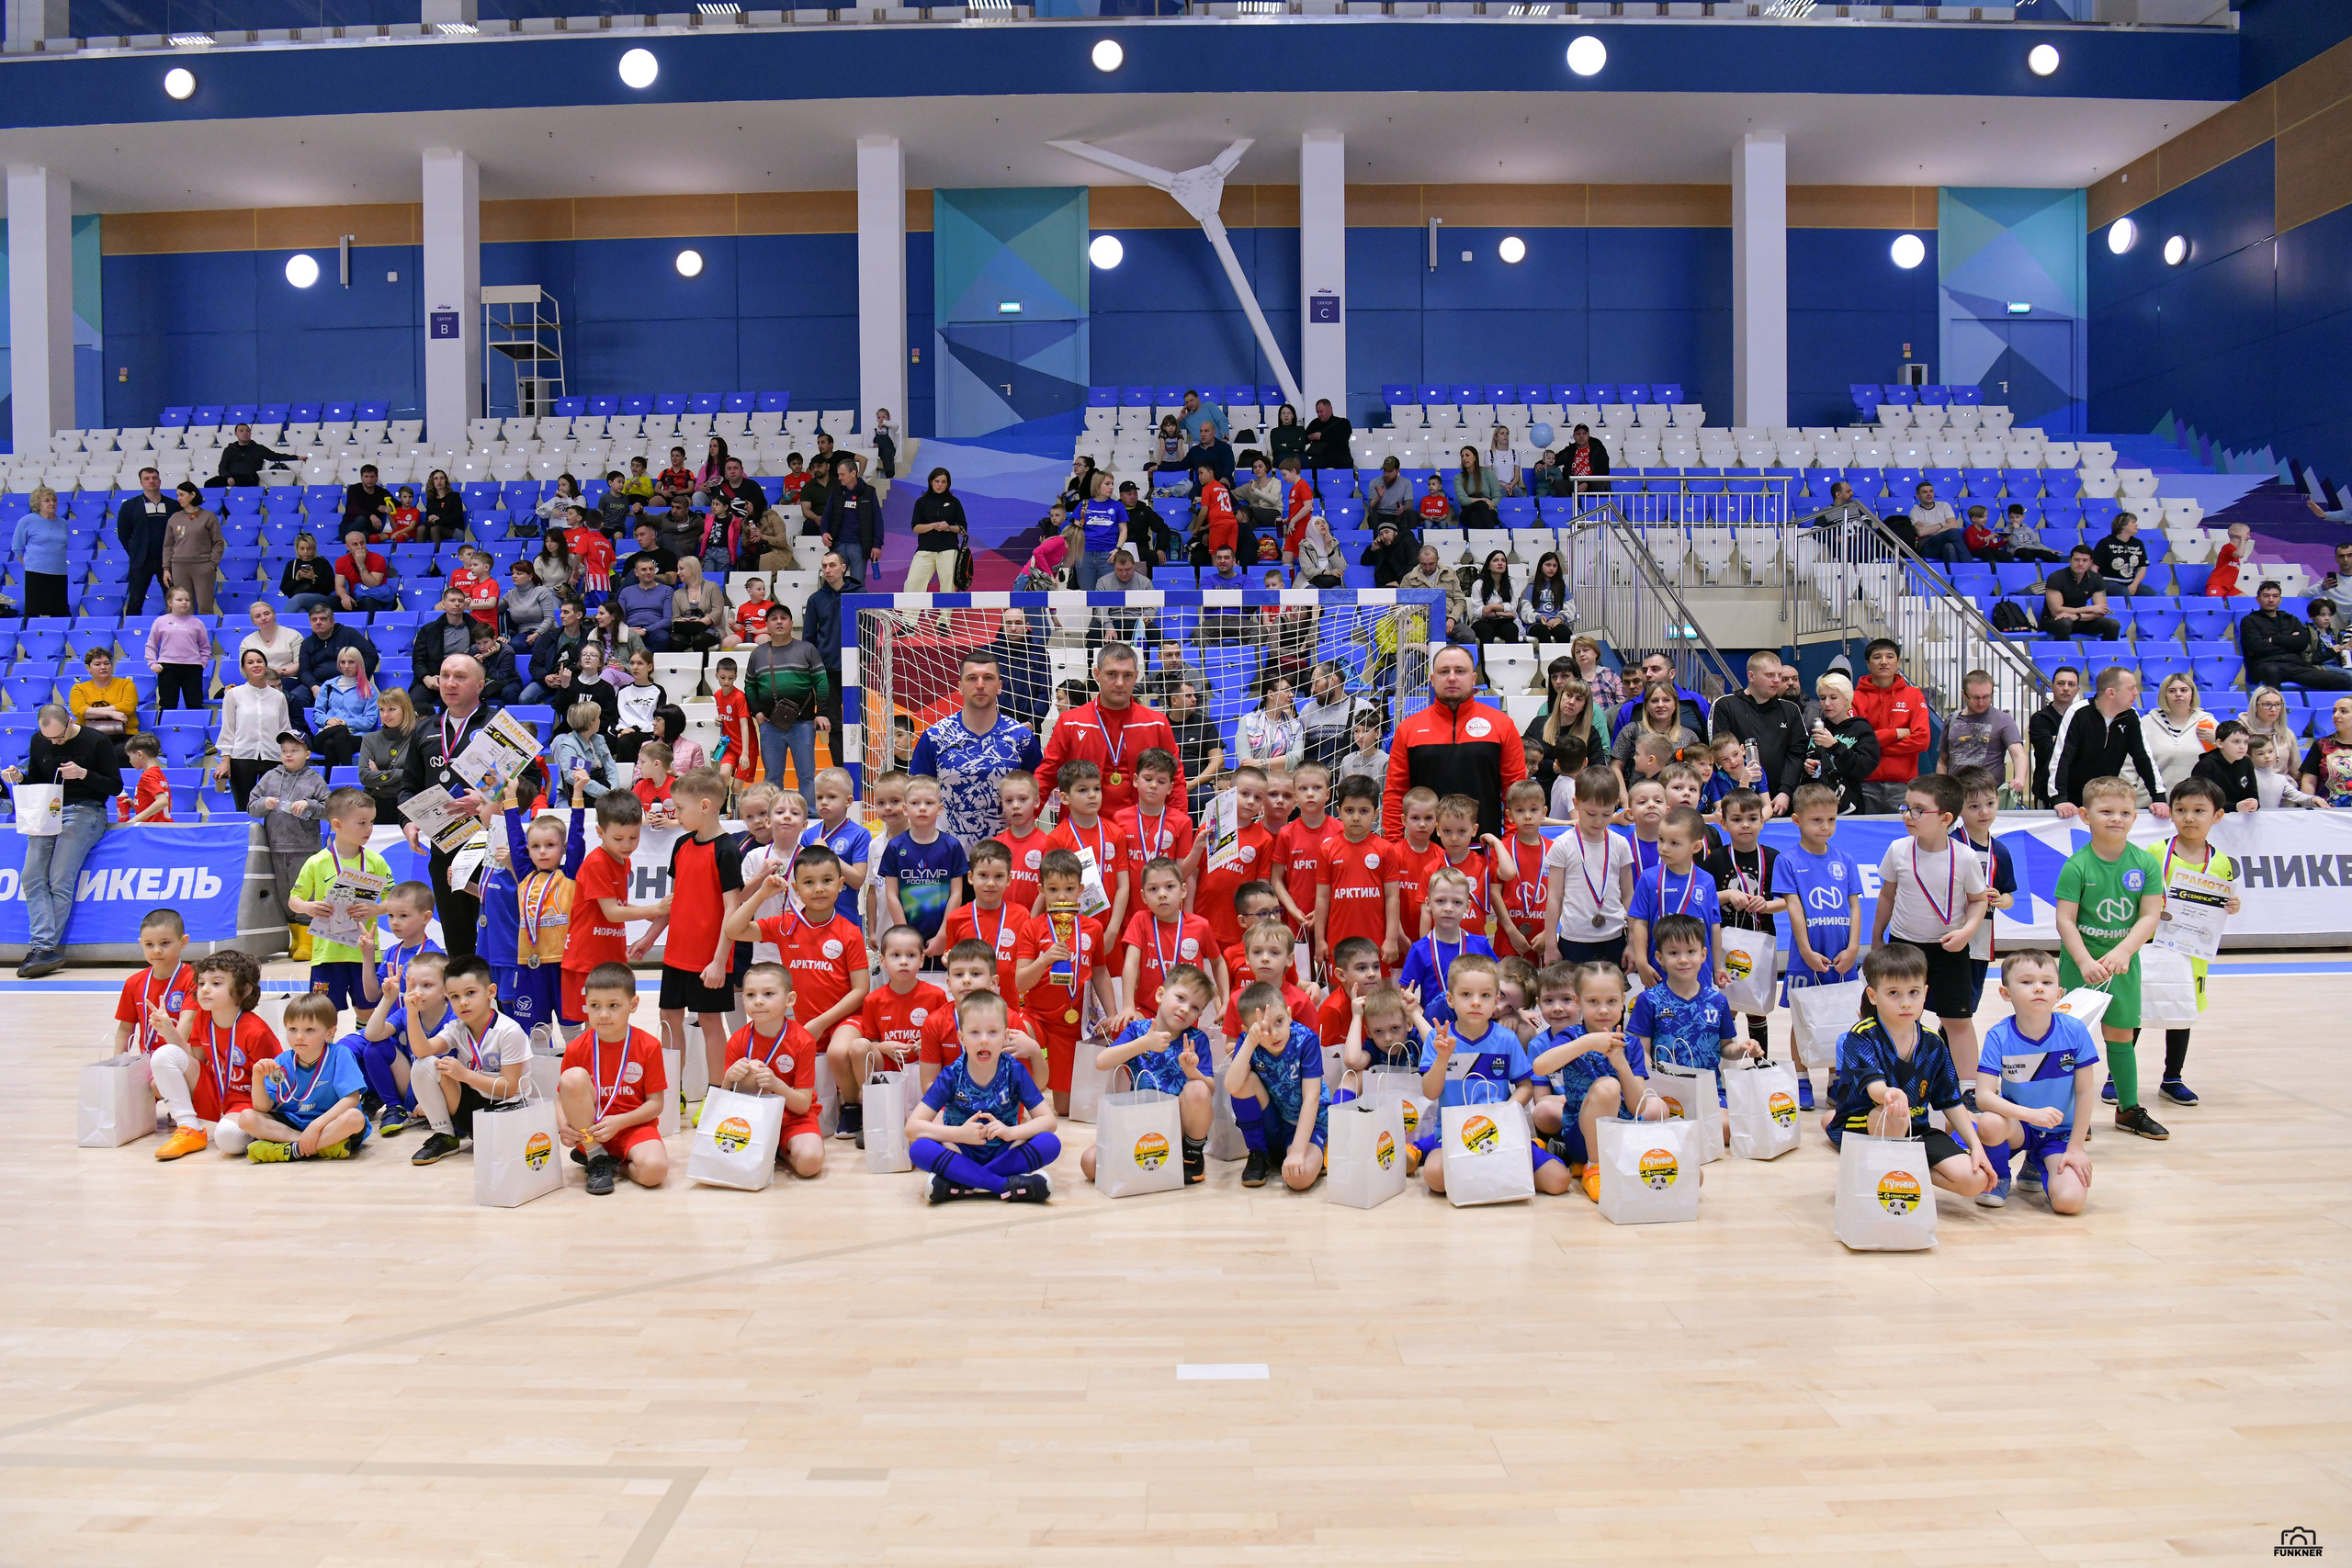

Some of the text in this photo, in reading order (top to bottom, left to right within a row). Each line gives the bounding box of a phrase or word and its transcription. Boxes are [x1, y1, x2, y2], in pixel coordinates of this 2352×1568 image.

[1217, 491, 1232, 513] 13
[598, 549, 606, 568] 7
[497, 713, 538, 753] ГРАМОТА
[442, 824, 481, 850] ДИПЛОМ
[1209, 847, 1238, 867] ГРАМОТА
[1294, 859, 1317, 870] АРКТ
[341, 871, 383, 889] ГРАМОТА
[900, 869, 948, 879] OLYMP
[1399, 881, 1419, 891] АРКТ
[2176, 872, 2232, 895] ГРАМОТА
[1334, 886, 1381, 899] АРКТИКА
[2188, 893, 2212, 903] СЕМЕЧКА
[1728, 954, 1750, 964] ТУРНИР
[789, 959, 834, 972] АРКТИКА
[1704, 1009, 1719, 1024] 17
[884, 1029, 922, 1041] АРКТИКА
[1770, 1099, 1791, 1109] ТУРНИР
[723, 1123, 750, 1134] ТУРНИР
[1464, 1119, 1488, 1138] ТУРНИР
[529, 1139, 549, 1150] ТУРНИР
[1138, 1140, 1166, 1150] ТУРНИР
[1643, 1156, 1674, 1167] ТУРНИР
[1883, 1180, 1917, 1192] ТУРНИР
